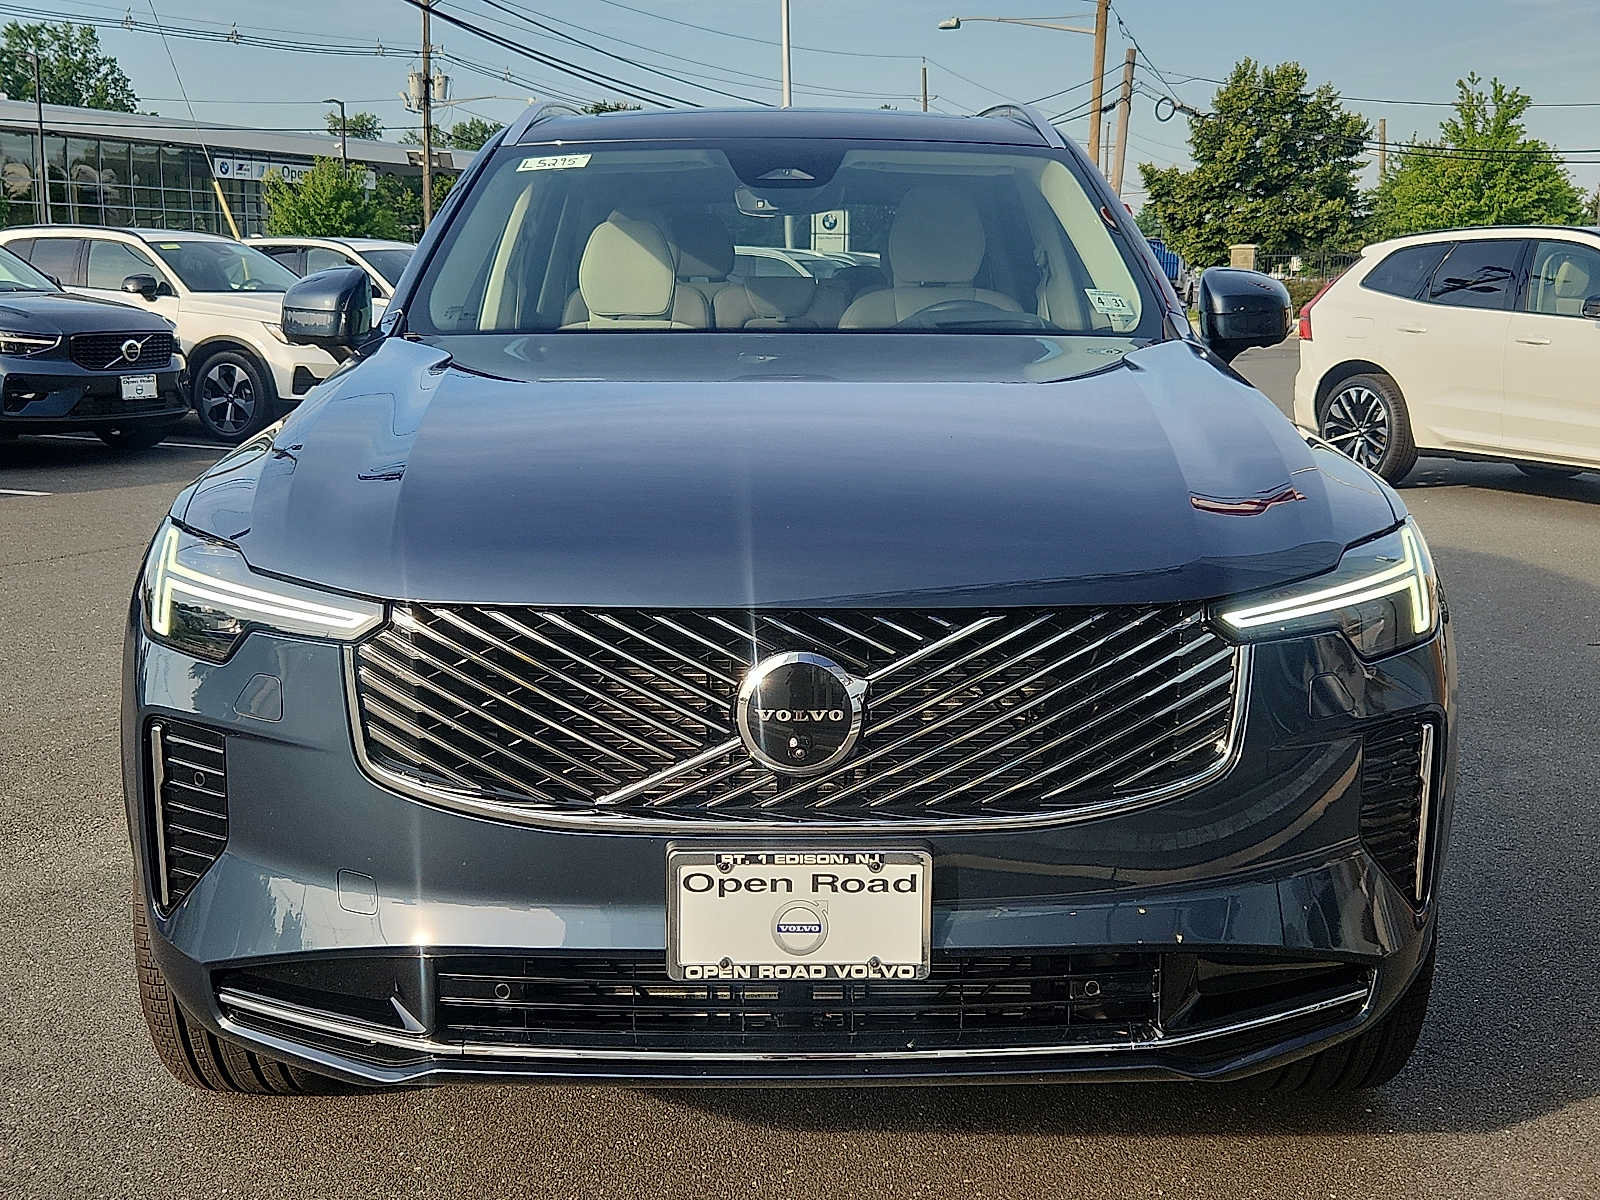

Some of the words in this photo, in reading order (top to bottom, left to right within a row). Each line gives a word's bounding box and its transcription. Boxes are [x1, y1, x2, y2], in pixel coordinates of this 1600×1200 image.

[1097, 296, 1105, 306] 4
[1111, 298, 1127, 308] 31
[754, 708, 845, 722] VOLVO
[721, 854, 750, 866] RT.
[757, 854, 767, 865] 1
[774, 854, 849, 865] EDISON,
[855, 853, 880, 865] NJ
[682, 872, 793, 898] Open
[811, 873, 917, 893] Road
[684, 965, 751, 979] OPEN
[758, 965, 827, 979] ROAD
[833, 964, 915, 979] VOLVO
